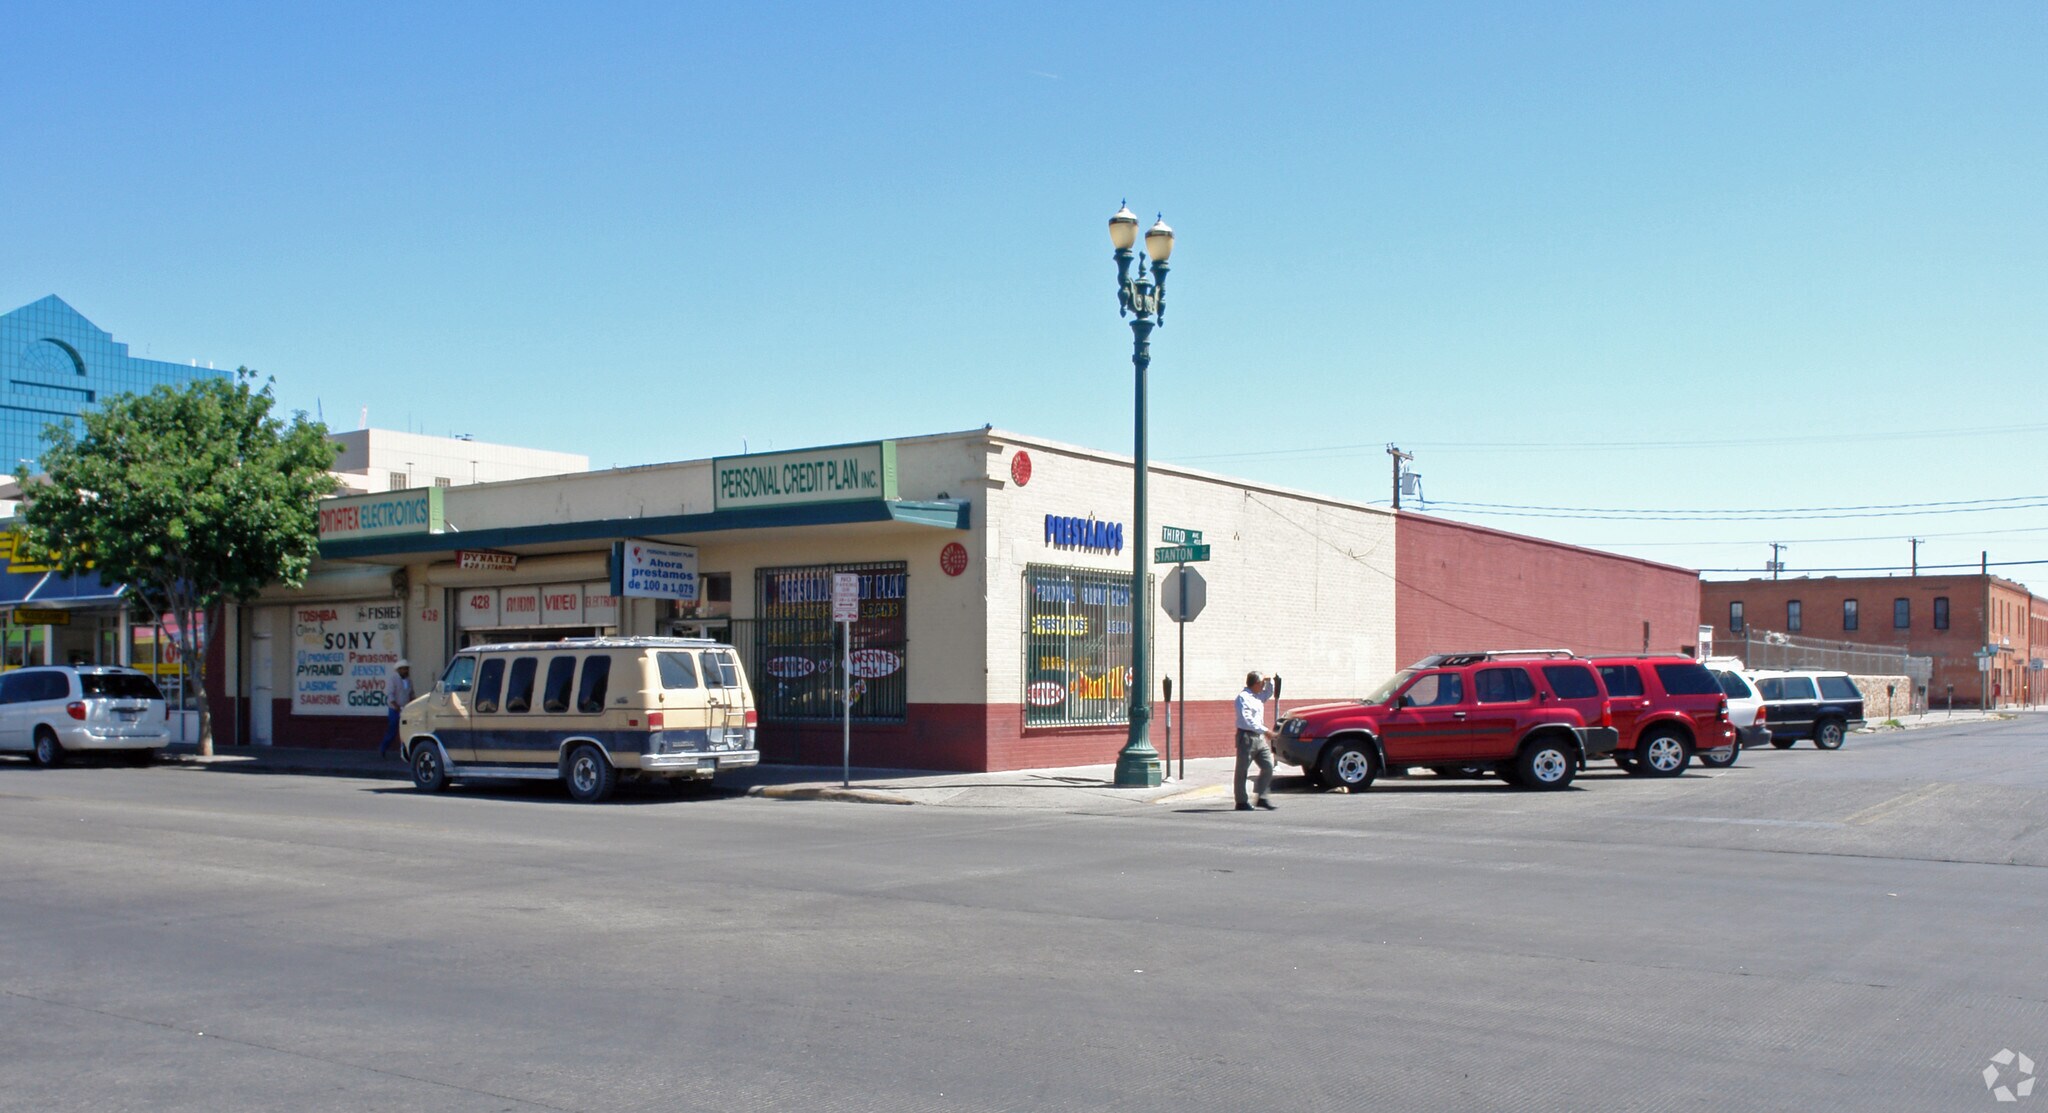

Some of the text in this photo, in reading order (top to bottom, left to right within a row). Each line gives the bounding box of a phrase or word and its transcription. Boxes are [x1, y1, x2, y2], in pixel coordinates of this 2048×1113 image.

[721, 458, 878, 499] PERSONAL CREDIT PLAN INC.
[320, 498, 427, 533] DINATEX ELECTRONICS
[1045, 514, 1123, 551] PRESTAMOS
[1163, 528, 1186, 543] THIRD
[464, 553, 513, 564] DYNATEX
[1155, 548, 1193, 562] STANTON
[649, 558, 683, 569] Ahora
[631, 568, 693, 581] prestamos
[628, 580, 640, 589] de
[644, 580, 660, 591] 100
[662, 584, 668, 592] a
[470, 595, 490, 609] 428
[506, 596, 535, 612] AUDIO
[544, 594, 577, 611] VIDEO
[298, 609, 338, 622] TOSHIBA
[422, 608, 438, 621] 428
[1037, 618, 1084, 631] PRESTAOS
[324, 632, 376, 650] SONY
[349, 651, 398, 664] Panasonic
[296, 664, 344, 676] PYRAMID
[352, 665, 386, 676] JENSEN
[768, 661, 811, 672] SERVICO
[860, 666, 878, 676] TAX
[300, 694, 341, 705] SAMSUNG
[347, 690, 388, 707] GoldSt
[1027, 688, 1061, 699] SERVICO
